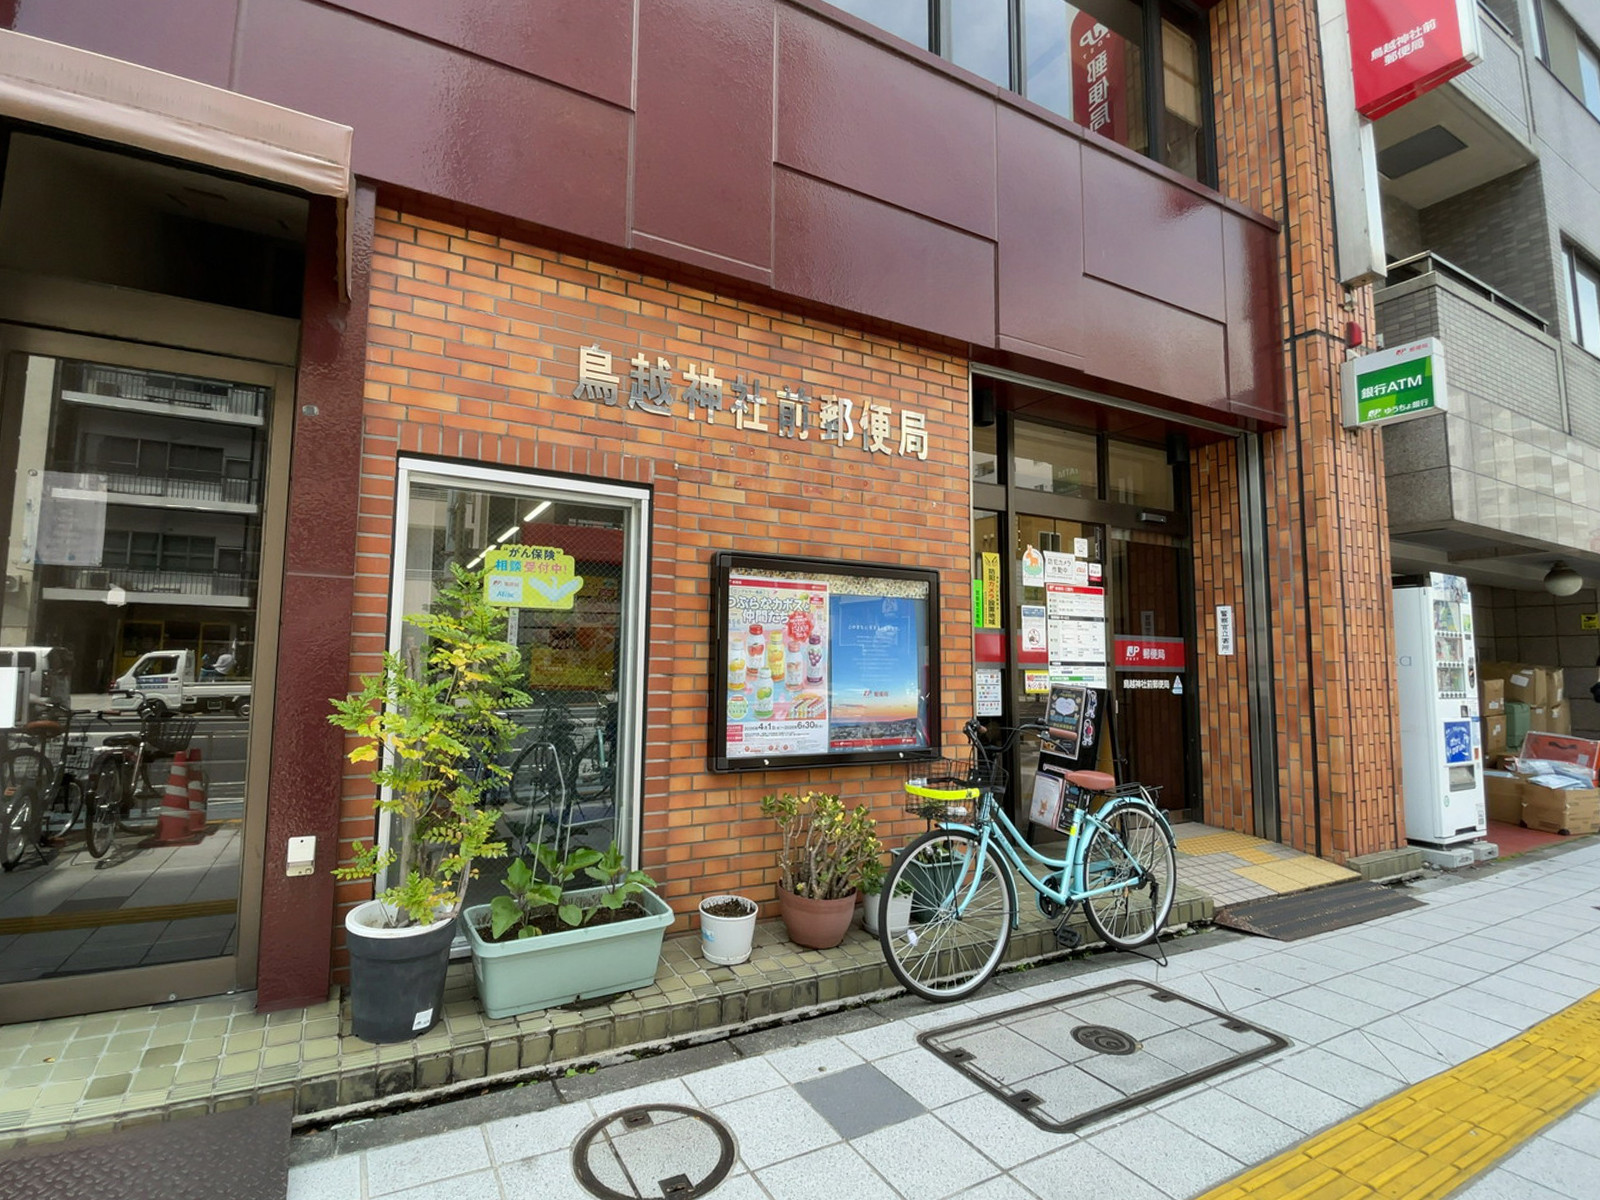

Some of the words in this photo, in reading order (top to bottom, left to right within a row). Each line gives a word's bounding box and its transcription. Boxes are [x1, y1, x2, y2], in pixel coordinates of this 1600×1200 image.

[1371, 18, 1437, 62] 鳥越神社前
[1384, 36, 1424, 66] 郵便局
[1361, 374, 1423, 399] 銀行ATM
[572, 344, 930, 462] 鳥越神社前郵便局
[1384, 398, 1428, 415] ゆうちょ銀行
[743, 608, 789, 625] 仲間たち
[1142, 648, 1166, 661] 郵便局
